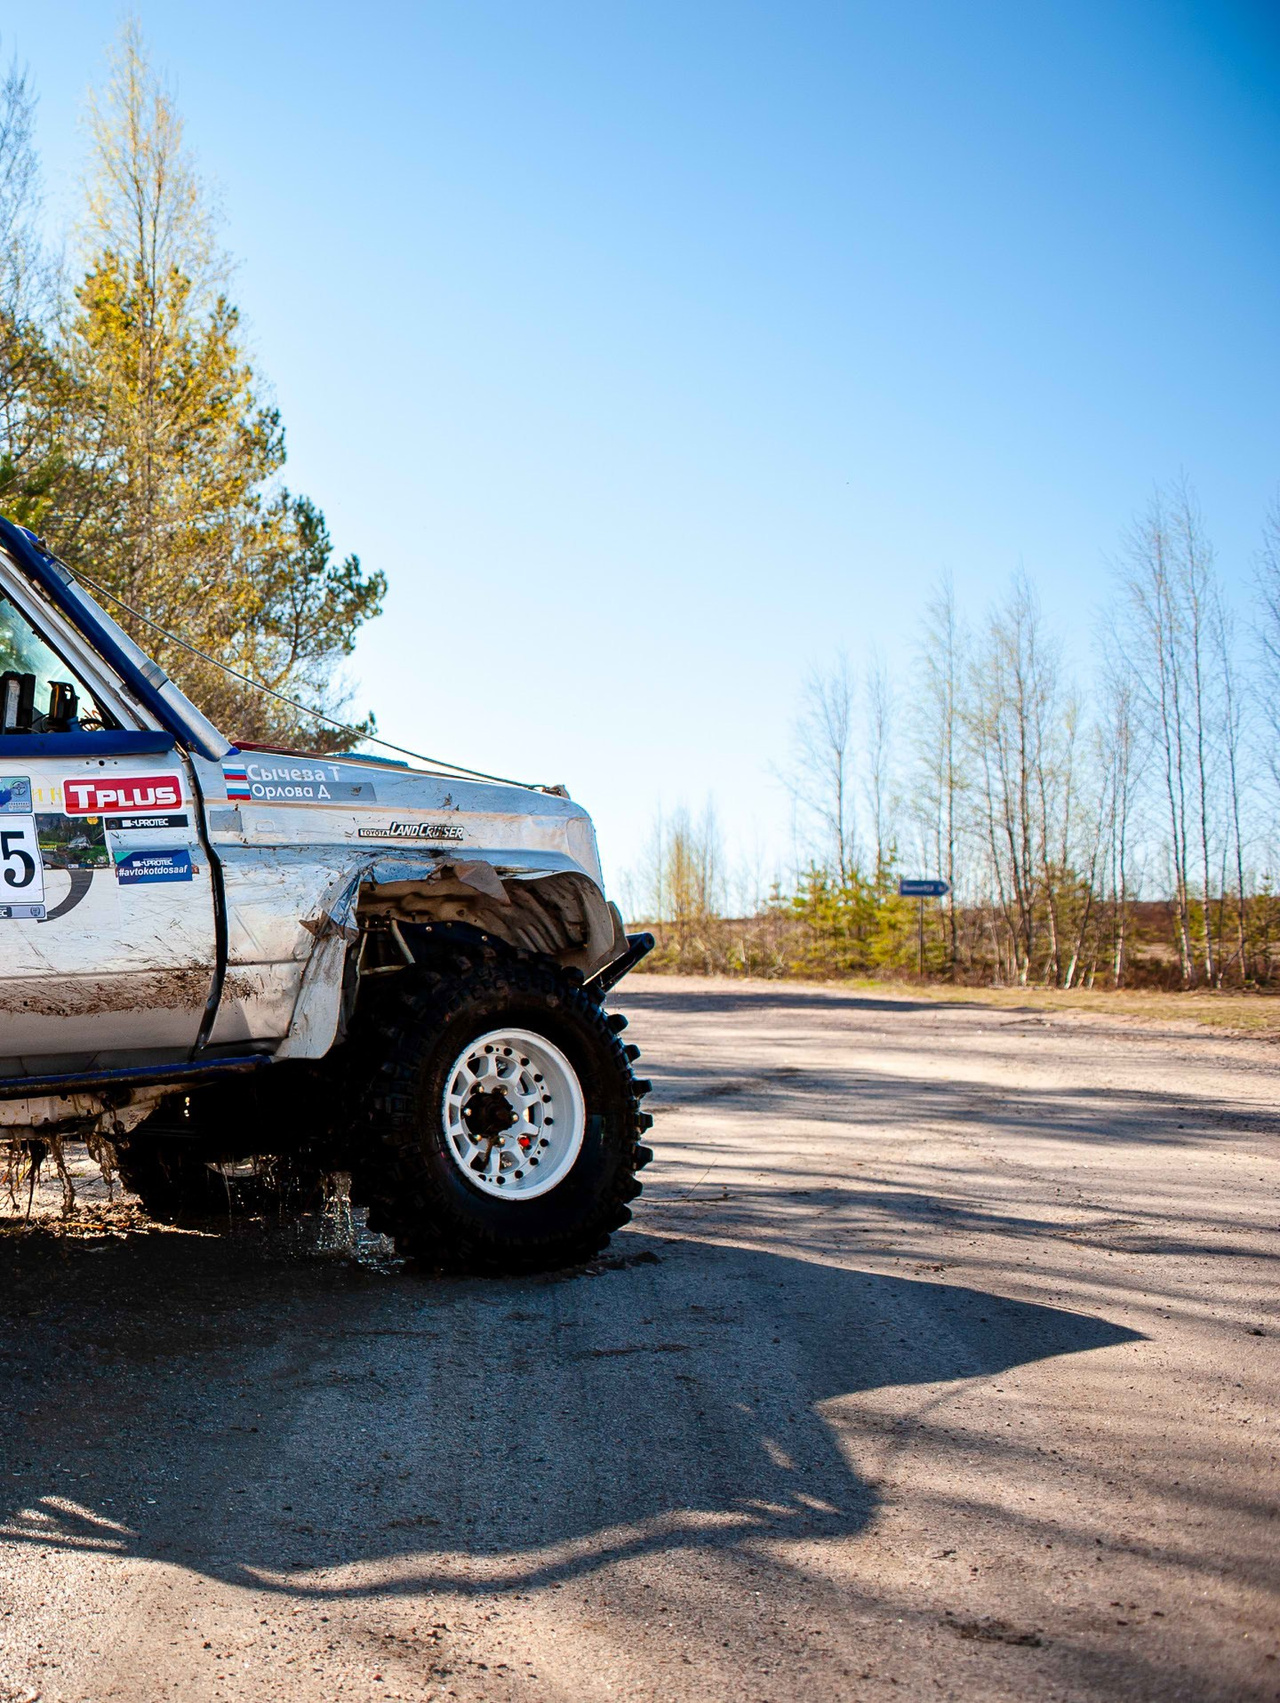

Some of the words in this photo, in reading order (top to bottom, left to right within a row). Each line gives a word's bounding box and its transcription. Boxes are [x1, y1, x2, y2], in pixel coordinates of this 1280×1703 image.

[246, 764, 326, 781] Сычева
[327, 765, 340, 782] Т
[69, 783, 177, 809] TPLUS
[251, 783, 314, 800] Орлова
[317, 784, 332, 800] Д
[124, 818, 169, 827] SUPROTEC
[360, 829, 390, 837] TOYOTA
[118, 865, 188, 877] #avtokotdosaaf
